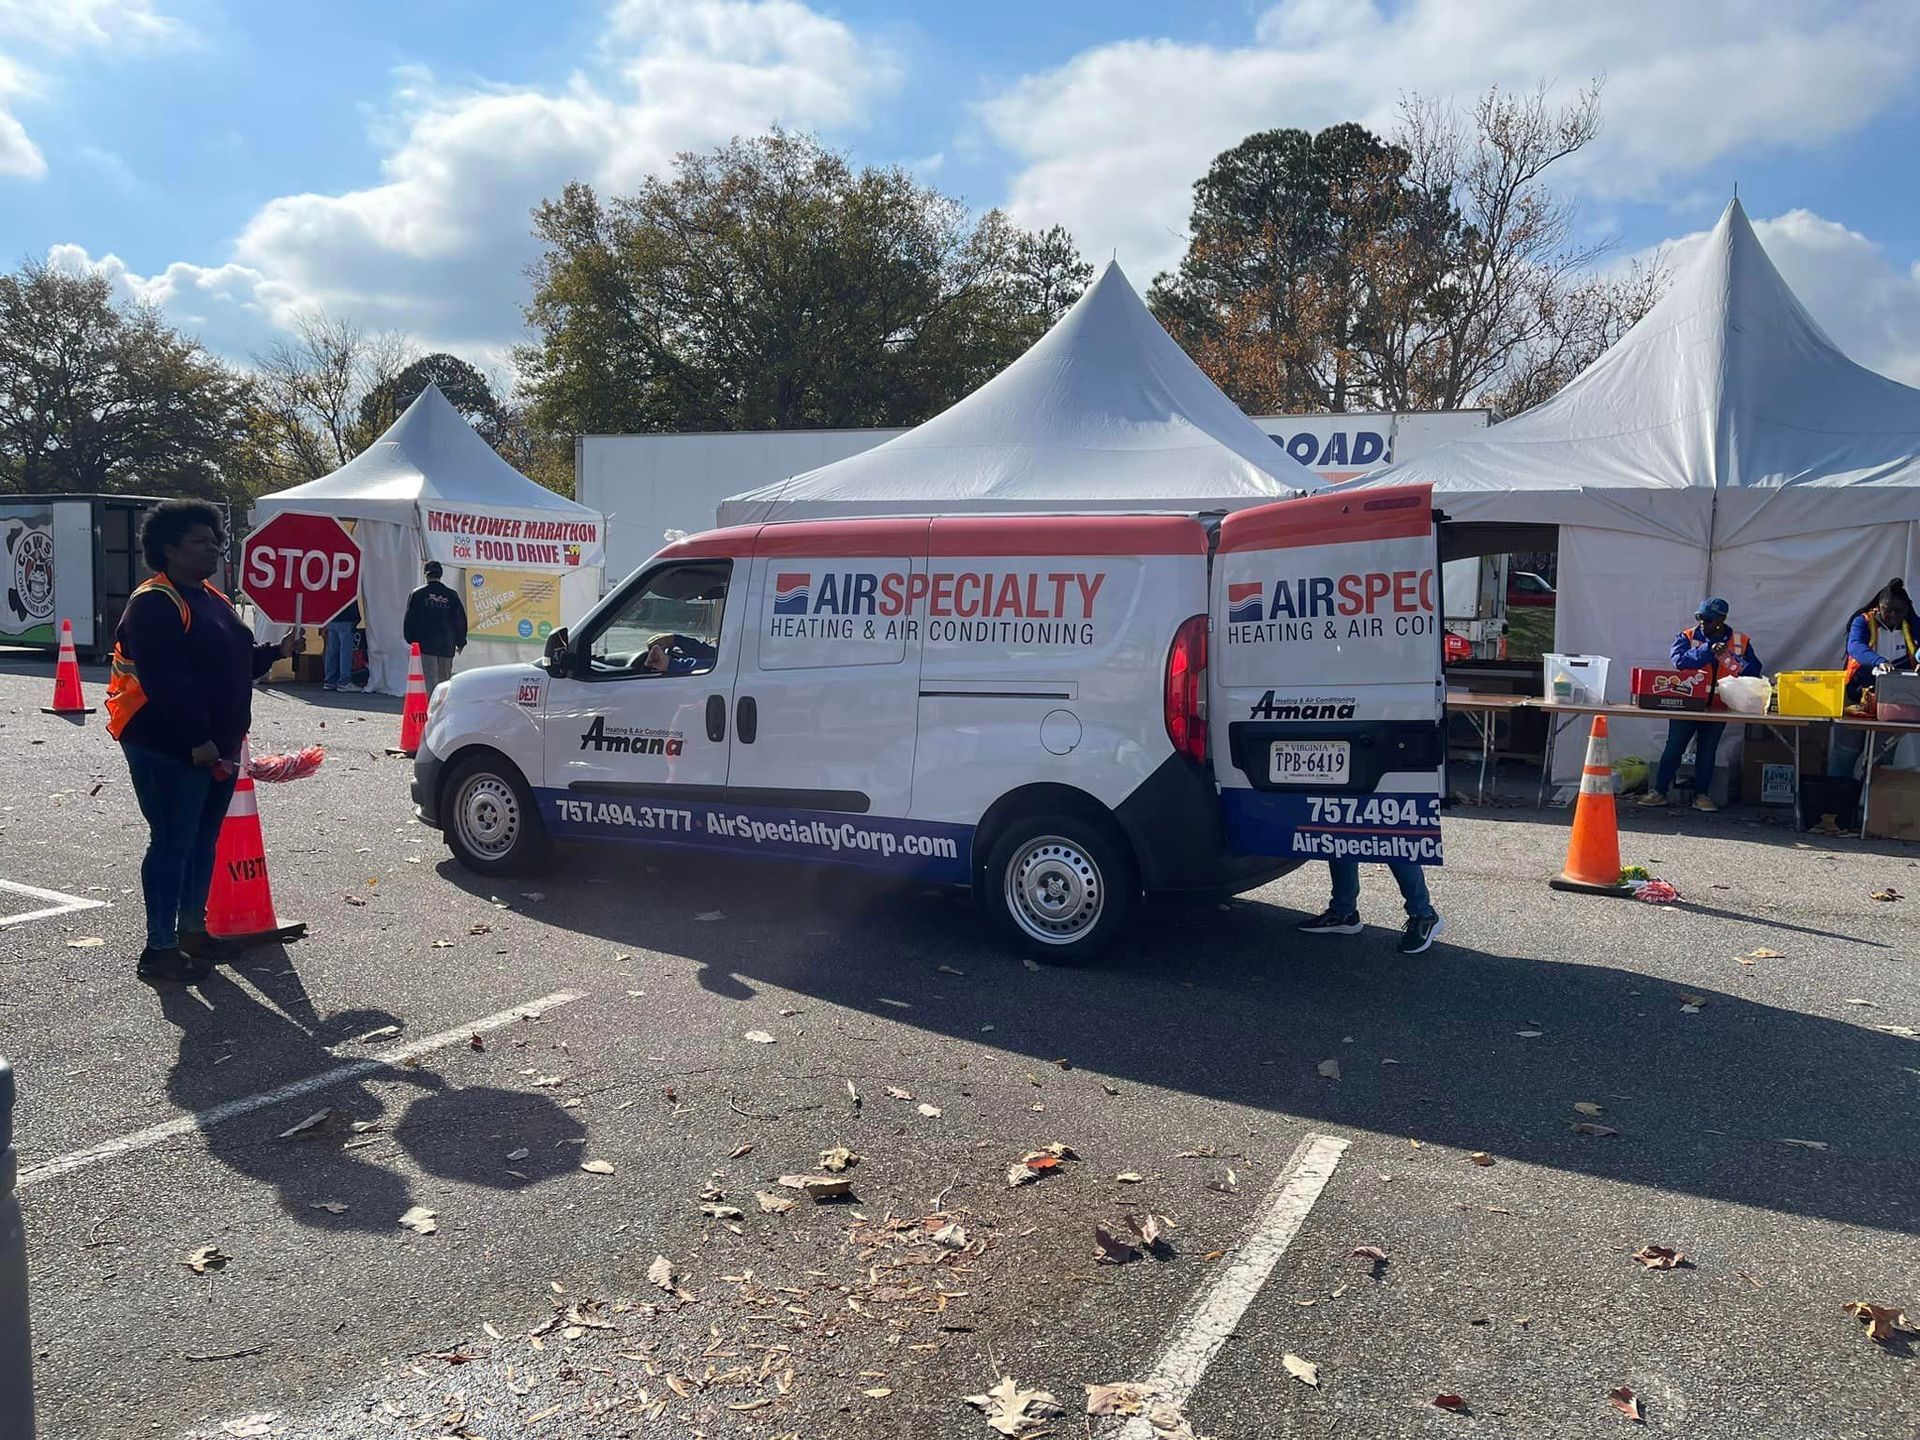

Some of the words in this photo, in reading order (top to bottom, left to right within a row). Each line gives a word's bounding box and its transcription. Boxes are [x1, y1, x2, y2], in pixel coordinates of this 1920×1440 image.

[428, 510, 521, 538] MAYFLOWER
[523, 519, 596, 543] MARATHON
[453, 546, 471, 558] FOX
[475, 540, 515, 562] FOOD
[516, 542, 560, 564] DRIVE
[248, 546, 356, 592] STOP
[475, 590, 516, 613] HUNGER
[813, 573, 1106, 618] AIRSPECIALTY
[477, 611, 512, 629] WASTE
[770, 618, 853, 639] HEATING
[863, 620, 876, 640] &
[885, 620, 919, 641] AIR
[929, 621, 1094, 645] CONDITIONING
[1228, 622, 1313, 644] HEATING
[1324, 621, 1338, 640] &
[1348, 618, 1384, 638] AIR
[518, 685, 540, 701] BEST
[1249, 689, 1356, 720] Amana
[580, 716, 684, 756] Amana
[605, 726, 628, 735] Heating
[645, 728, 684, 738] Conditioning
[1291, 744, 1329, 752] VIRGINIA
[1275, 752, 1345, 773] TPB-6419
[556, 800, 692, 832] 757.494.3777
[706, 812, 958, 859] AirSpecialtyCorp.com
